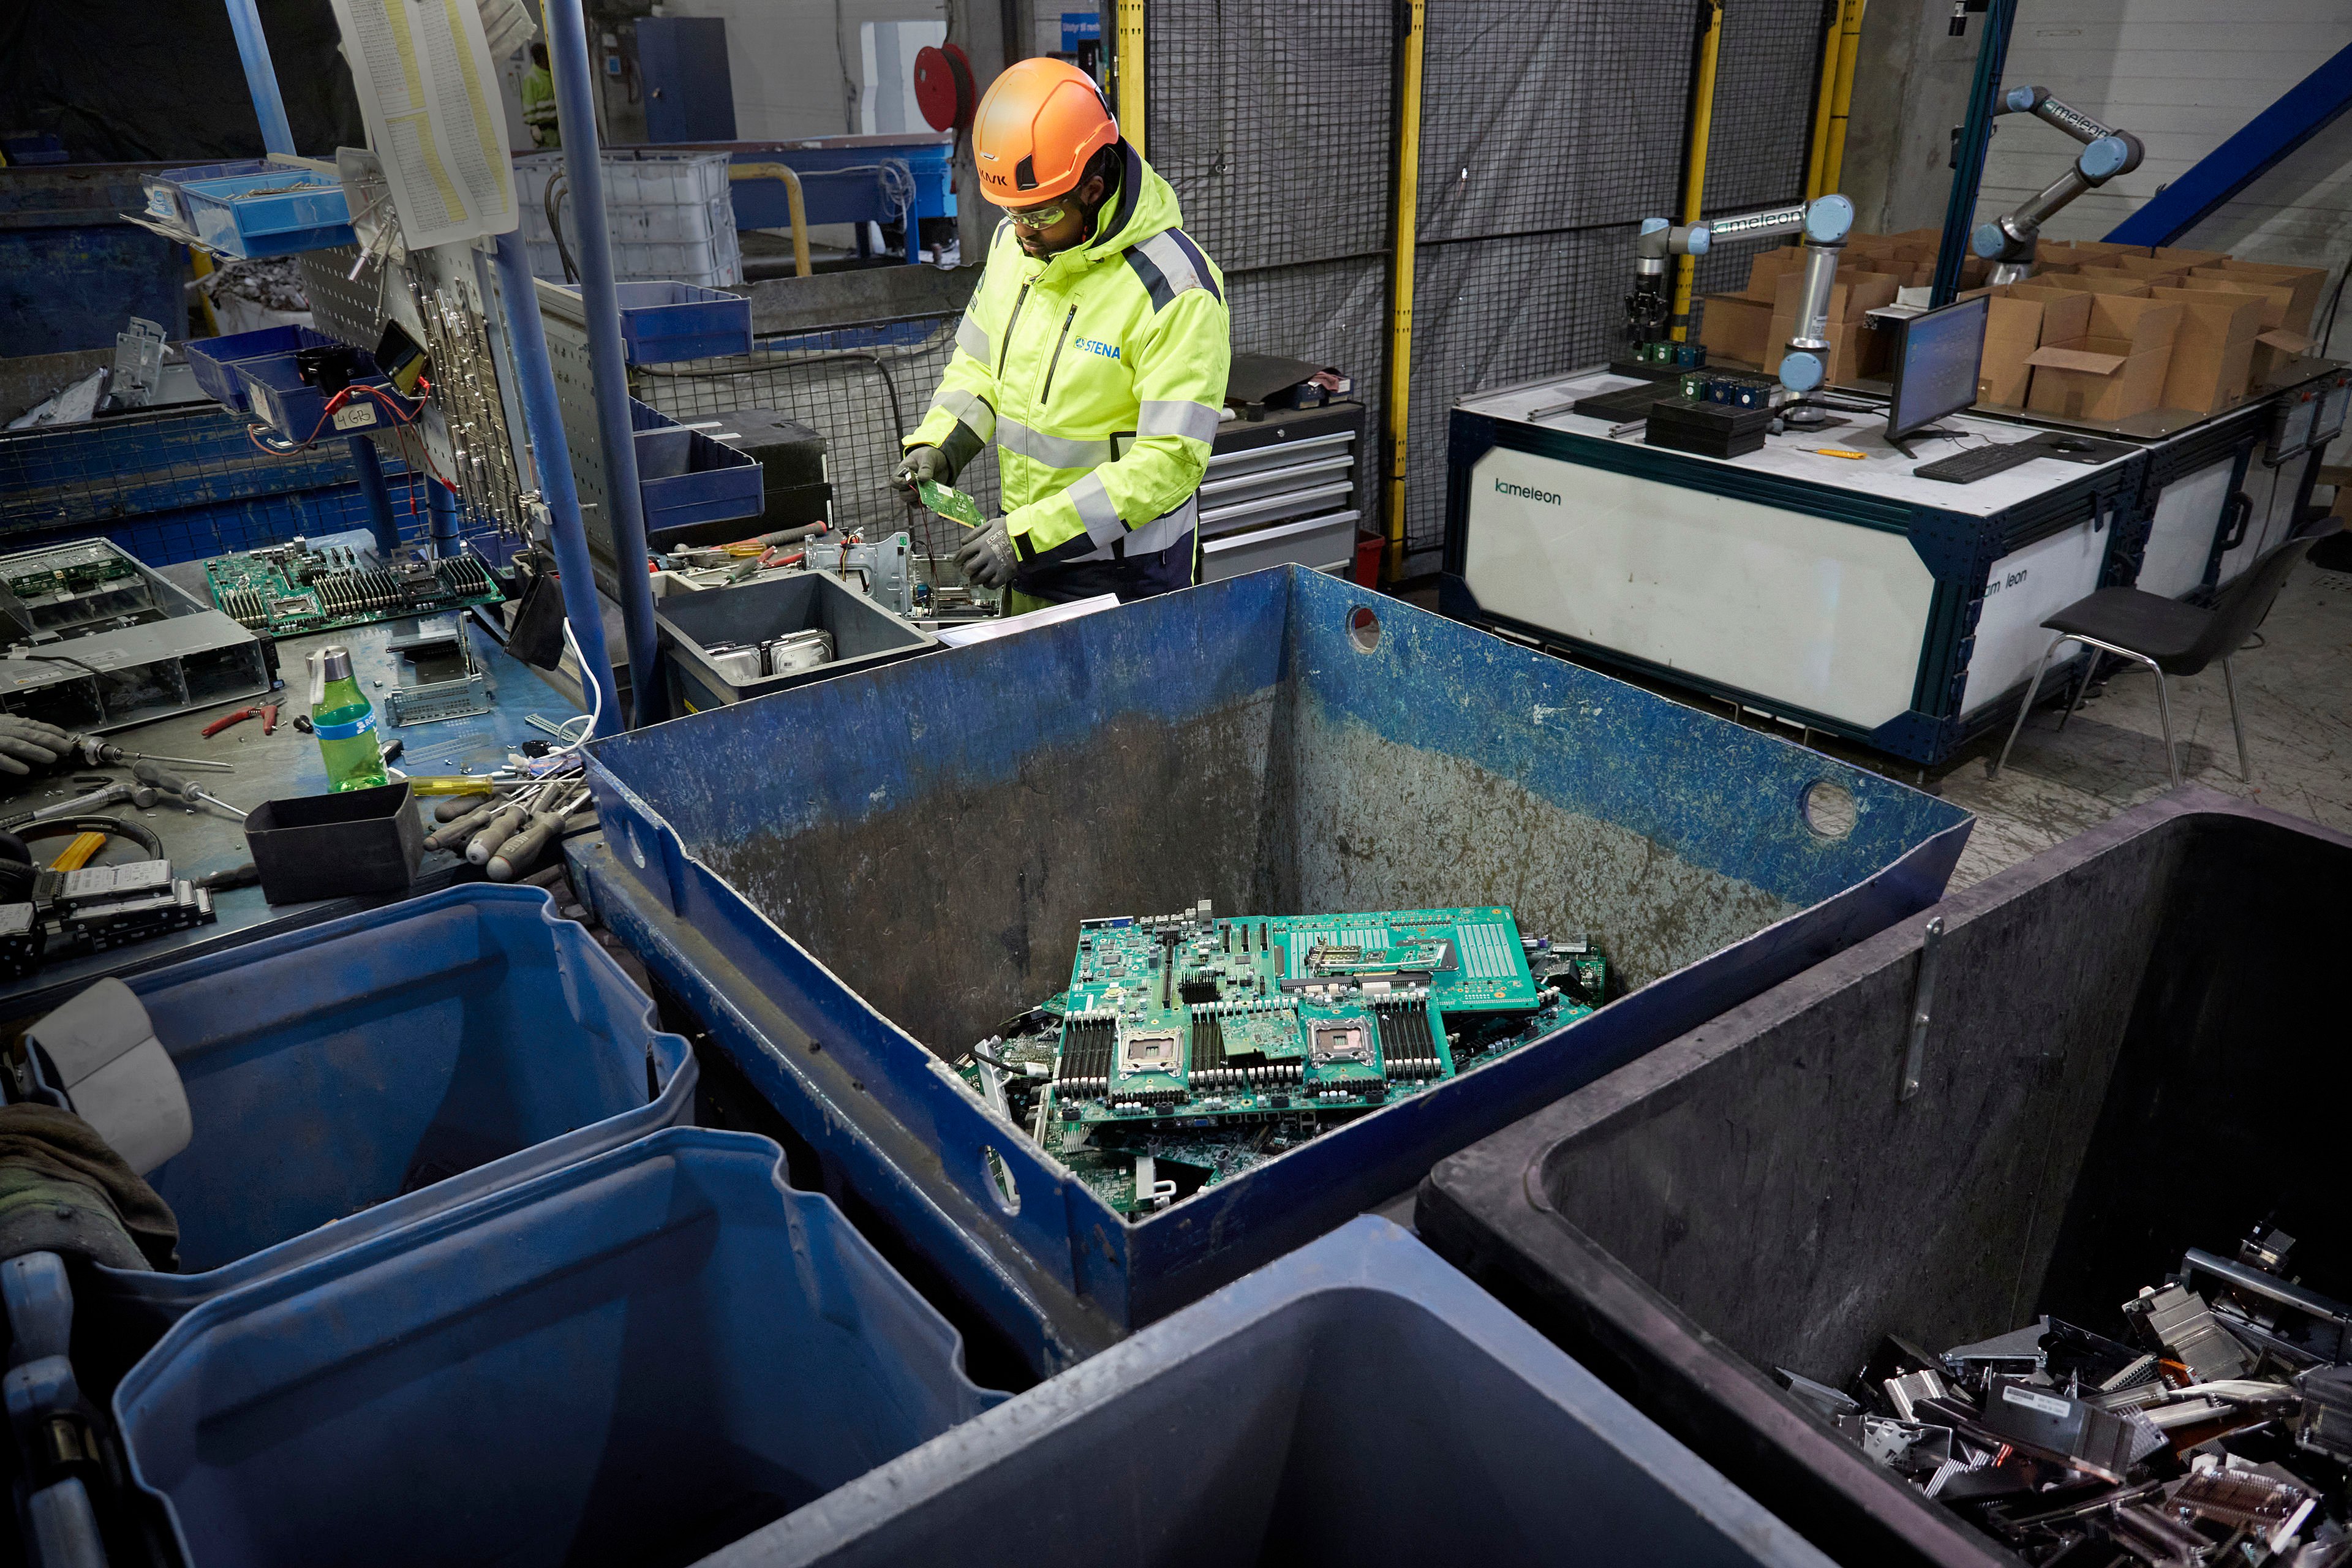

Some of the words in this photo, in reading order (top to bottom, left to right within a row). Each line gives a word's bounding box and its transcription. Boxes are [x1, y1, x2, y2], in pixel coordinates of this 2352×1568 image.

[2043, 100, 2109, 138] ameleon
[979, 167, 1008, 186] KASK
[1712, 211, 1802, 235] kameleon
[1085, 340, 1120, 360] STENA
[337, 412, 347, 427] 4
[349, 409, 371, 424] GB
[1495, 478, 1561, 506] kameleon
[986, 529, 1004, 545] GUIDE
